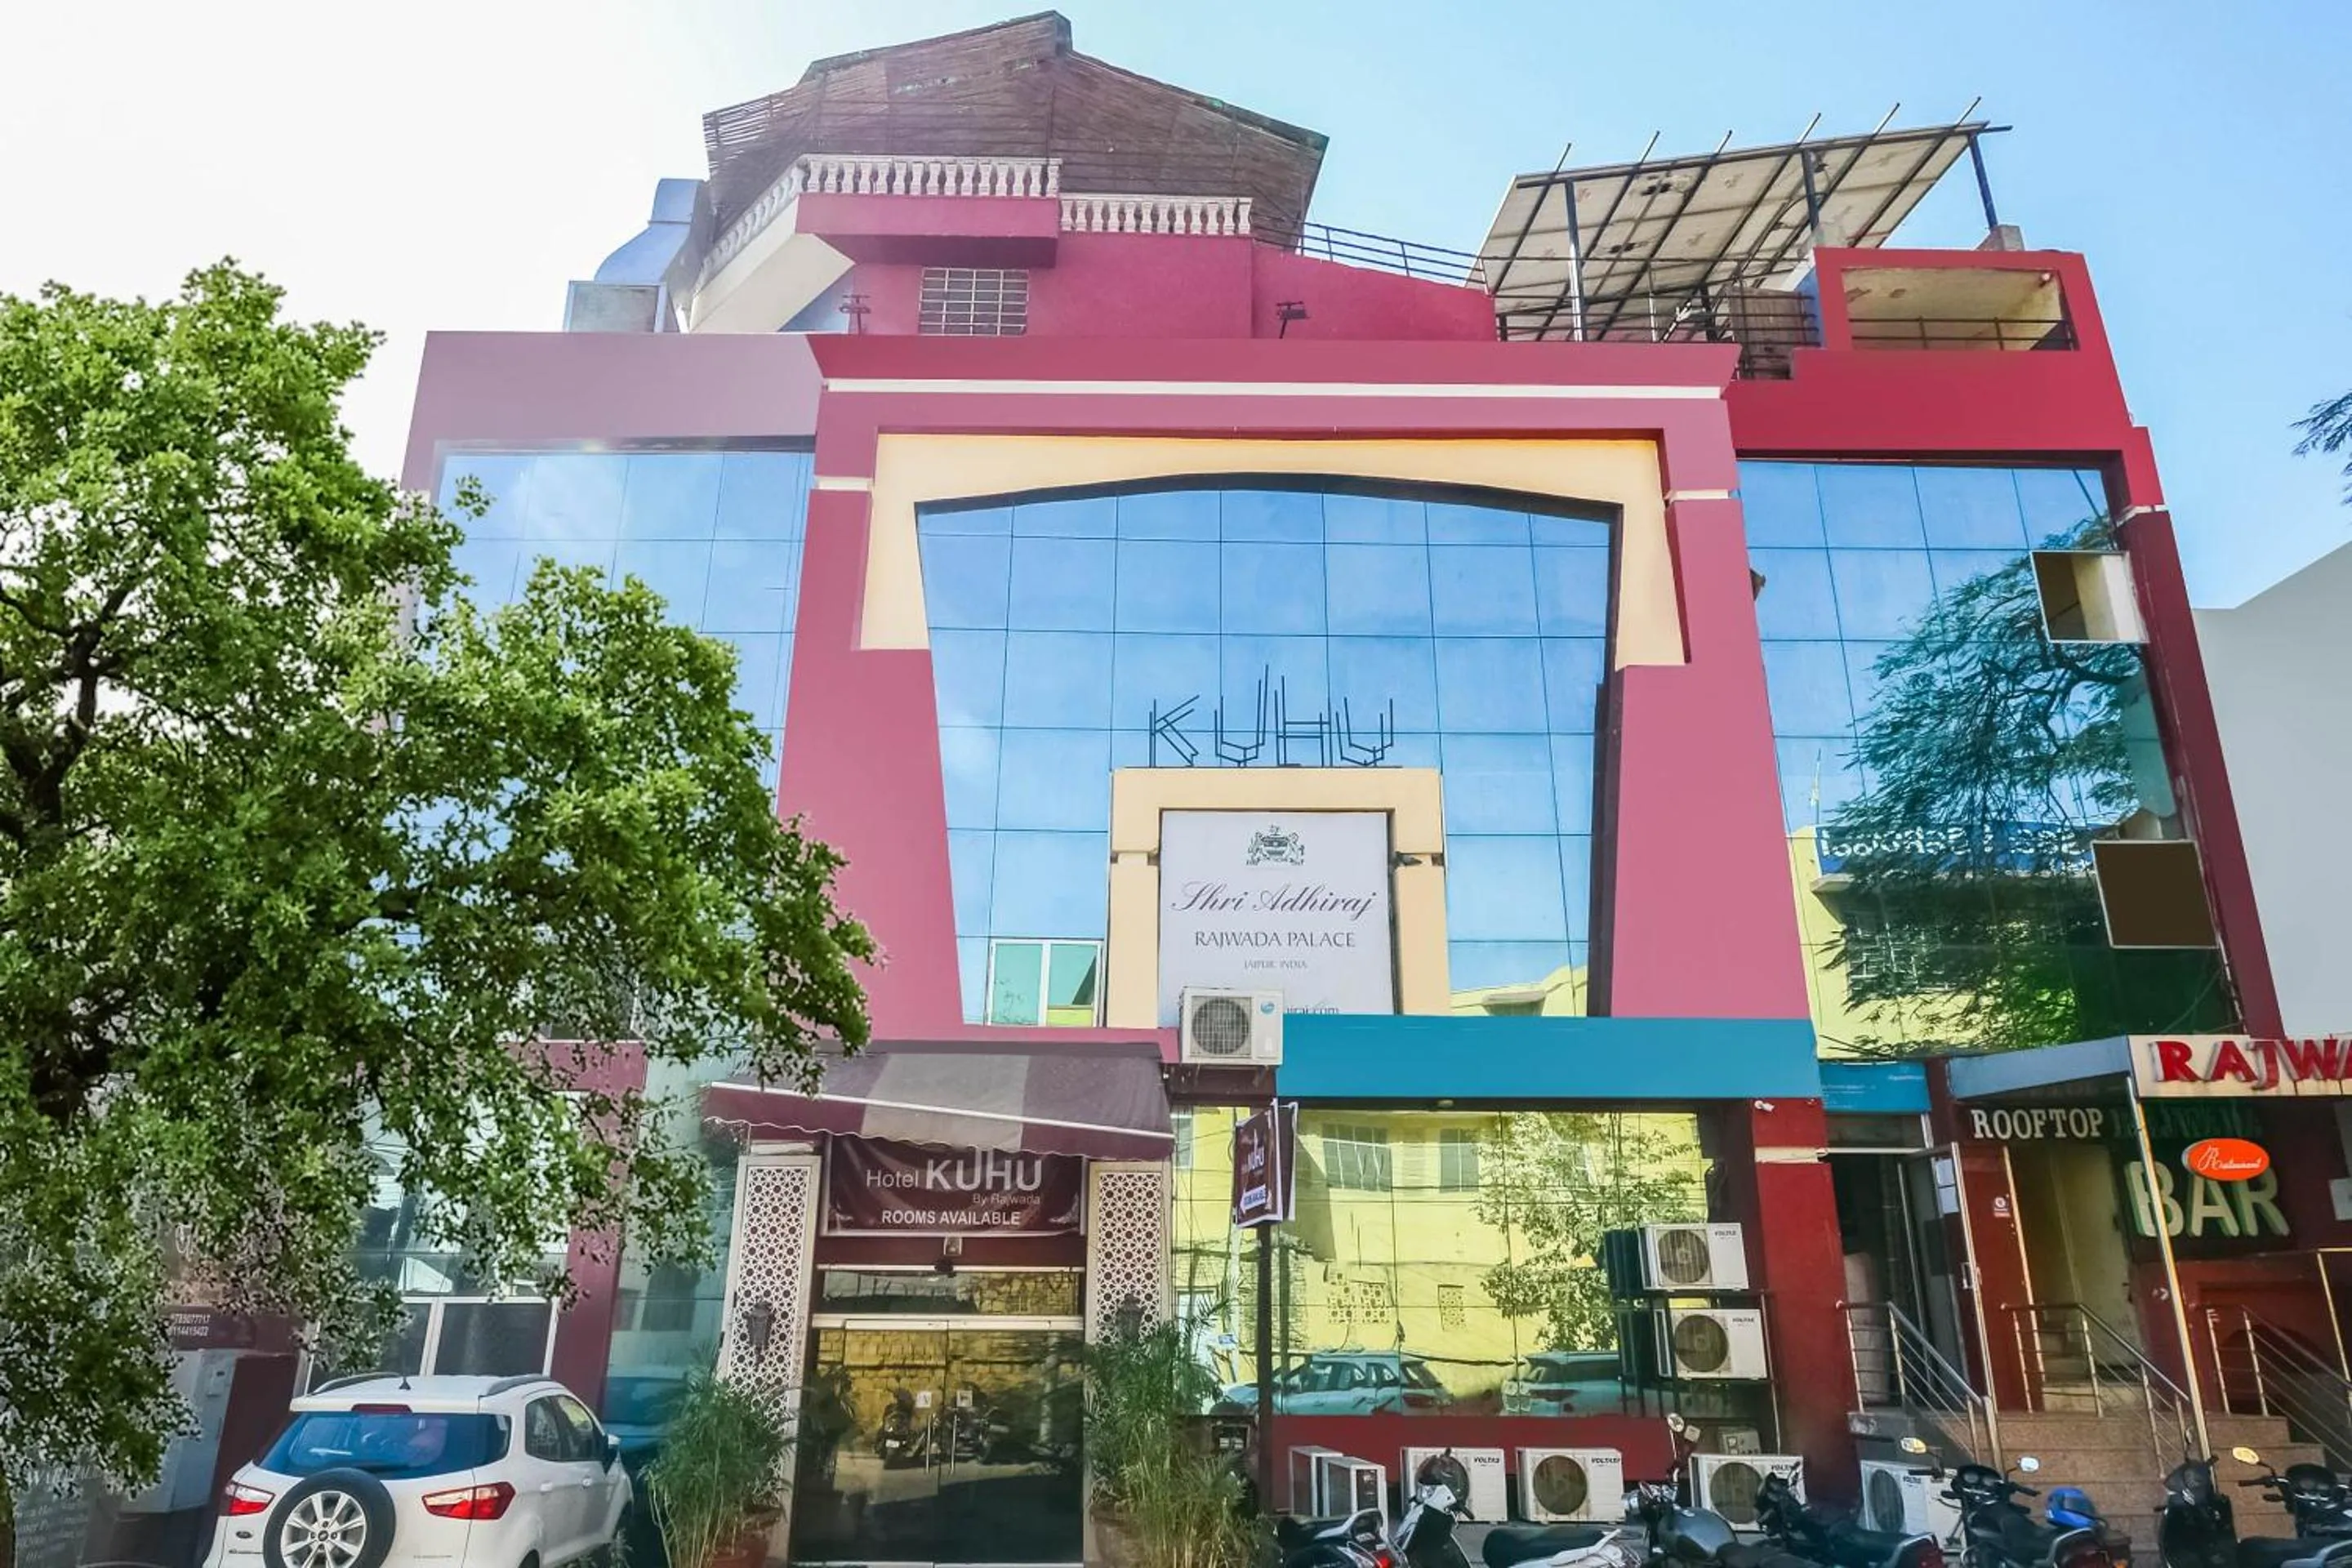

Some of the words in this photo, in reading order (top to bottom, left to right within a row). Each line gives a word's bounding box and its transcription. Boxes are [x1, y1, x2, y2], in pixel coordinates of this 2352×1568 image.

[1149, 664, 1394, 768] KUHU
[1171, 880, 1246, 912] Shri
[1252, 880, 1377, 921] Adhiraj
[1195, 930, 1280, 948] RAJWADA
[1287, 931, 1356, 948] PALACE
[1970, 1107, 2104, 1140] ROOFTOP
[866, 1169, 920, 1189] Hotel
[924, 1146, 1042, 1192] KUHU
[973, 1193, 987, 1207] By
[990, 1192, 1040, 1207] Rajwada
[2125, 1160, 2291, 1237] BAR
[881, 1209, 936, 1225] ROOMS
[939, 1209, 1021, 1226] AVAILABLE
